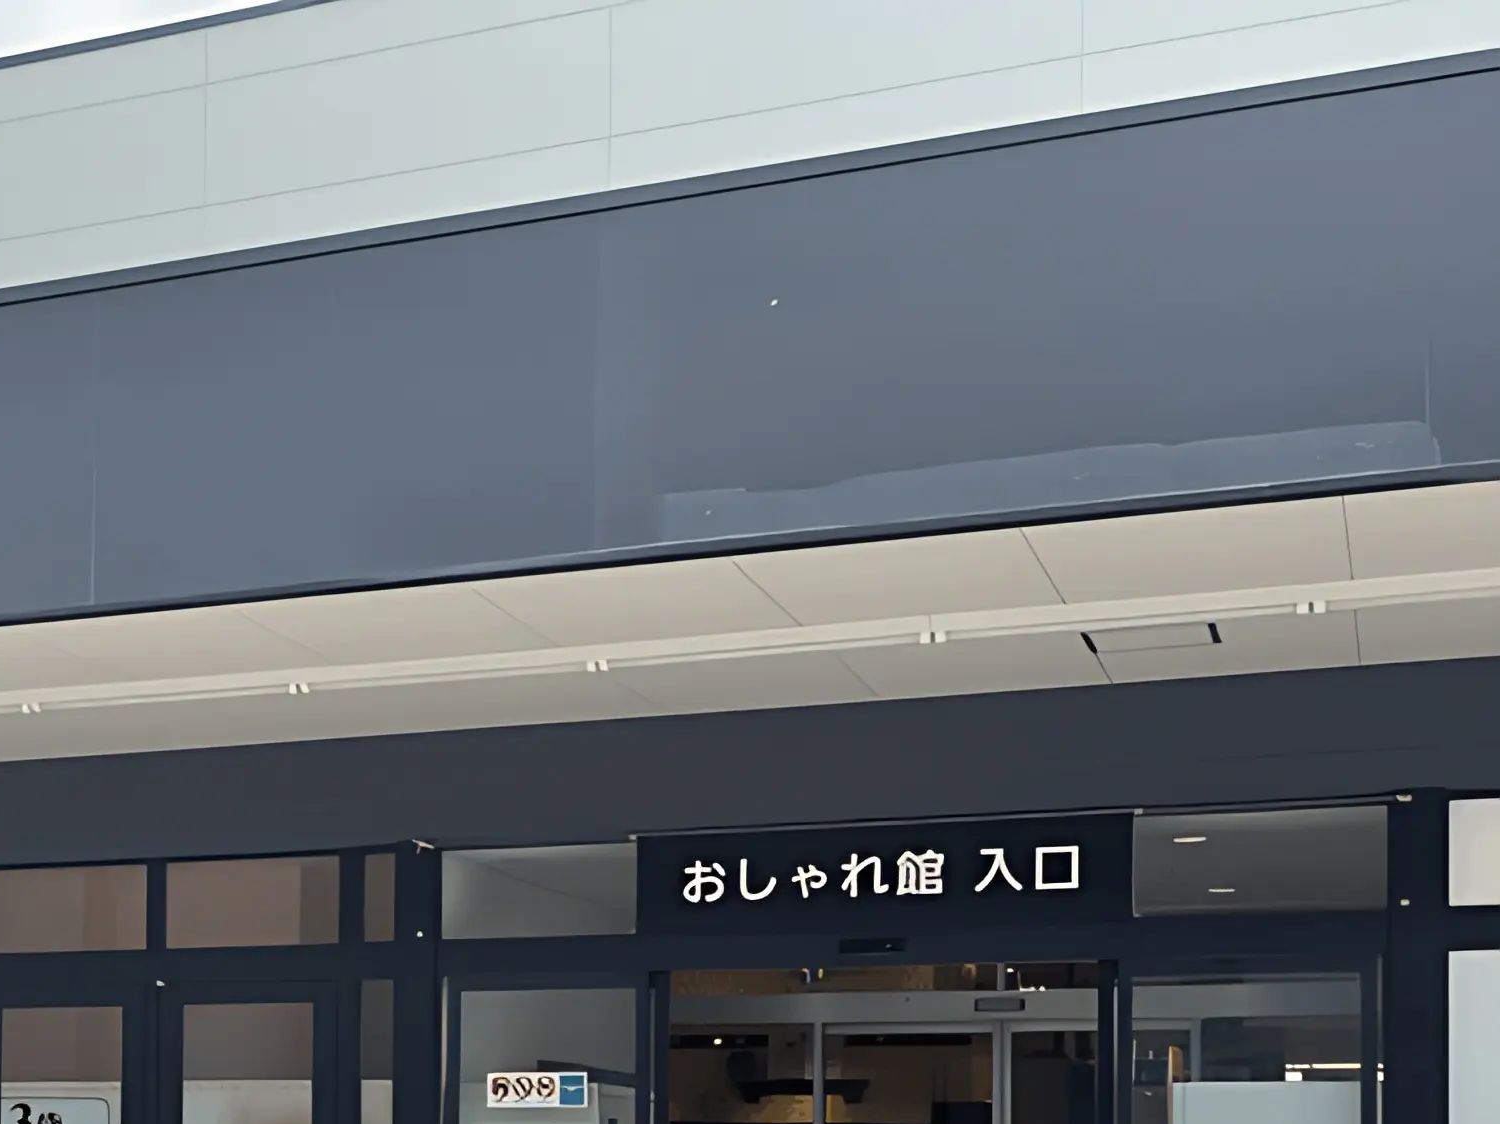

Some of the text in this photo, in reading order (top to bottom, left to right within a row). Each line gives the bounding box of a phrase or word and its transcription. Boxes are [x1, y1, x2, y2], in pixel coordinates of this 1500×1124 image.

[681, 844, 1081, 904] おしゃれ館 入口
